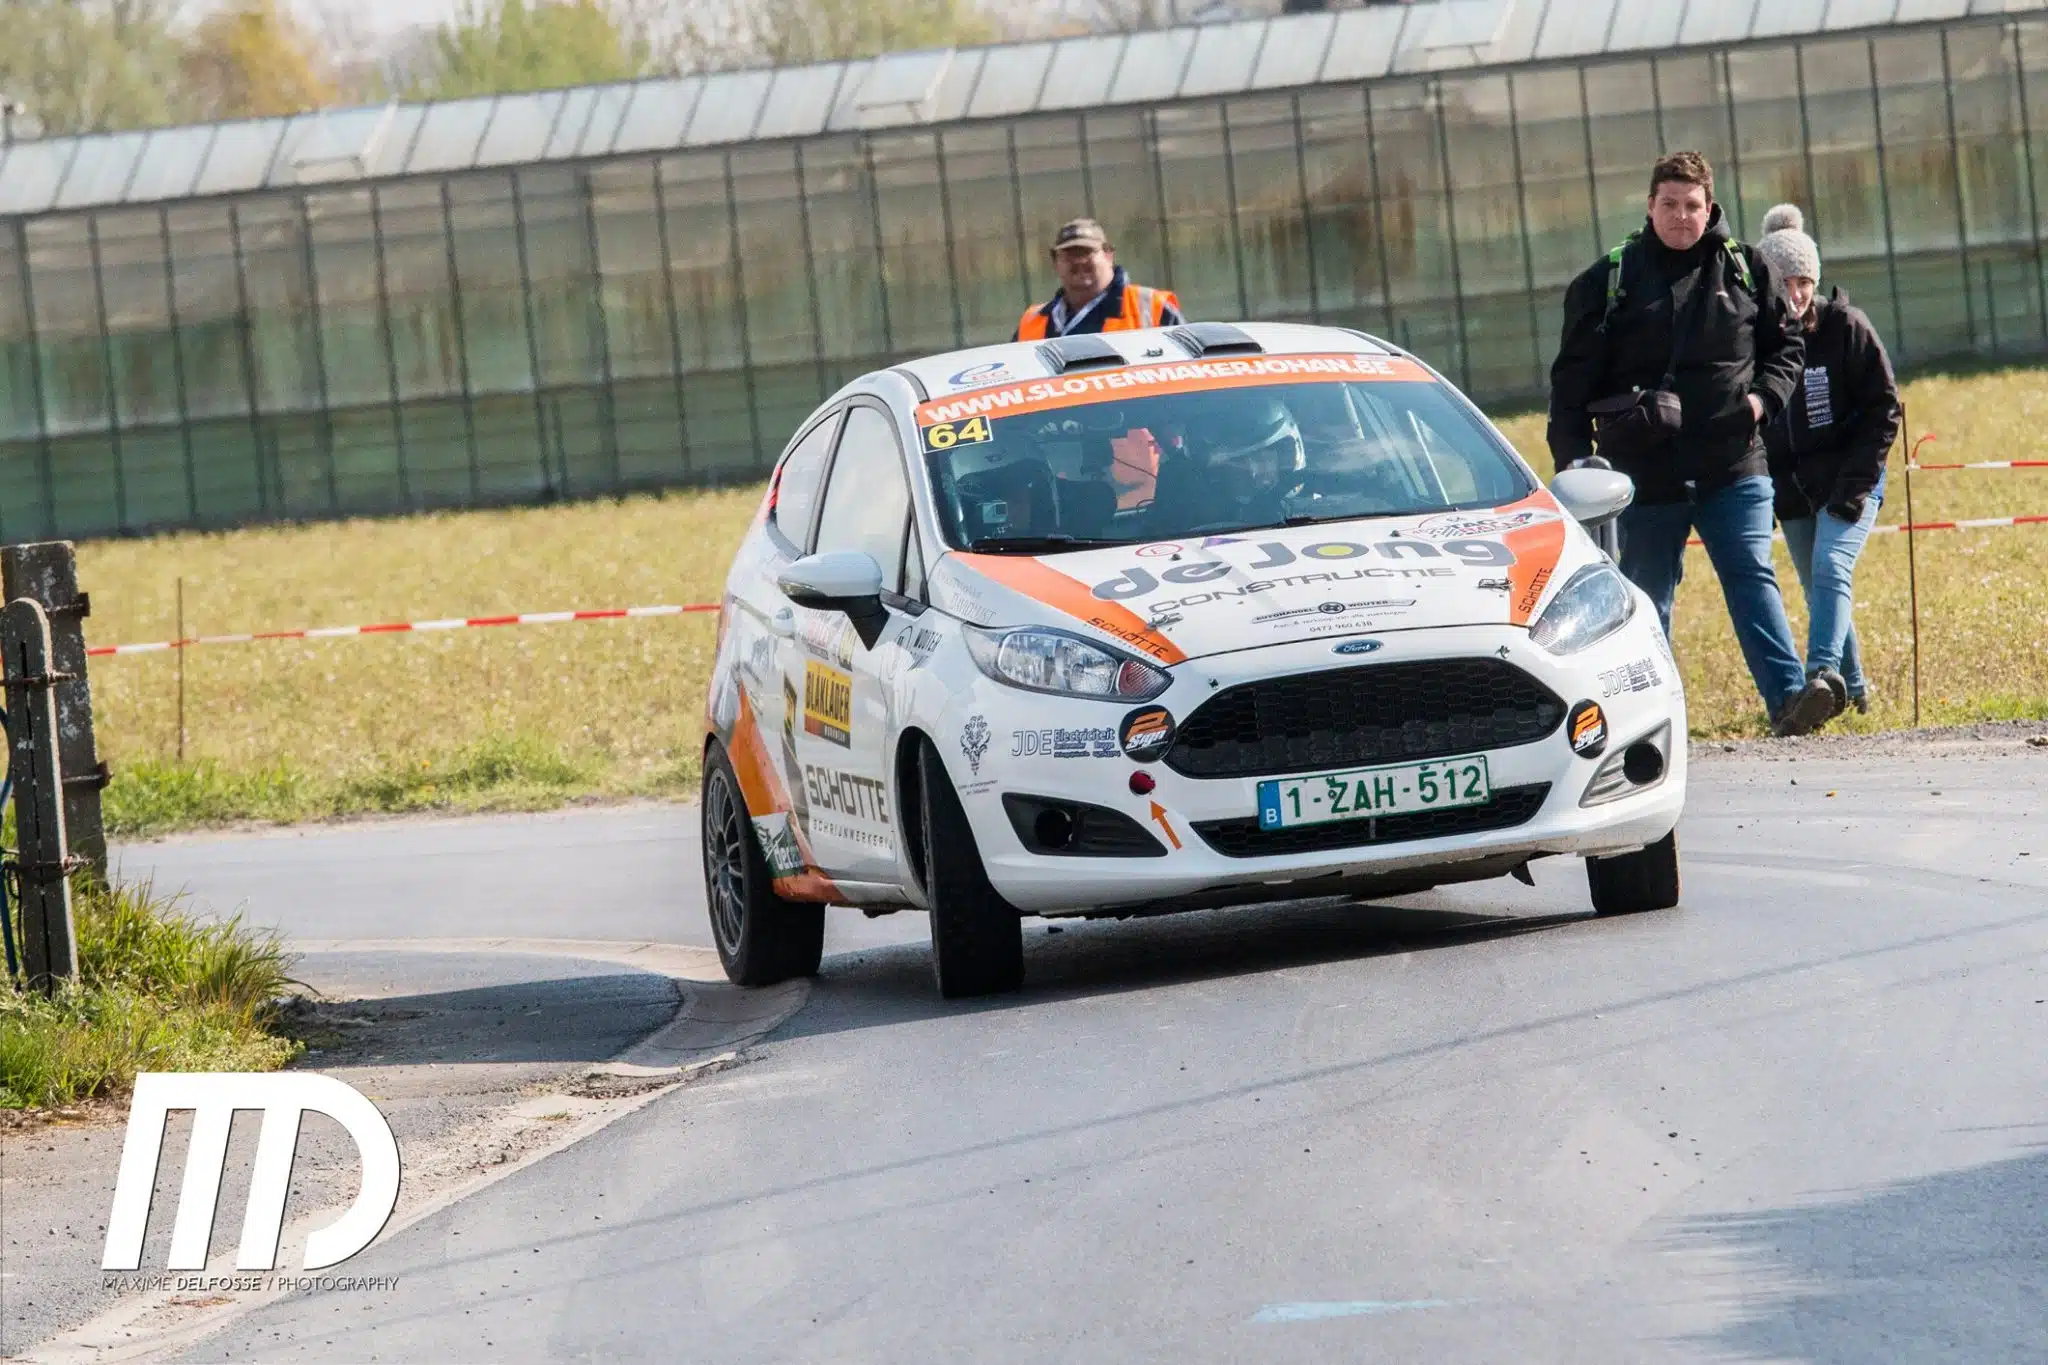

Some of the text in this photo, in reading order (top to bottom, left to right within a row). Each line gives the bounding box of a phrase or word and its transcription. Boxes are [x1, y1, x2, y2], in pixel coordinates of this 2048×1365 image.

[926, 357, 1395, 422] WWW.SLOTENMAKERJOHAN.BE
[928, 417, 988, 449] 64
[1092, 560, 1232, 600] de
[1149, 567, 1456, 615] CONSTRUCTIE
[1518, 568, 1553, 614] SCHOTTE
[1256, 600, 1389, 621] AUTOHANDEL WOUTER
[1088, 617, 1168, 659] SCHOTTE
[1597, 667, 1631, 698] JDE
[1012, 728, 1115, 757] JDE Electriciteit
[806, 764, 889, 824] SCHOTTE
[1266, 808, 1279, 825] B
